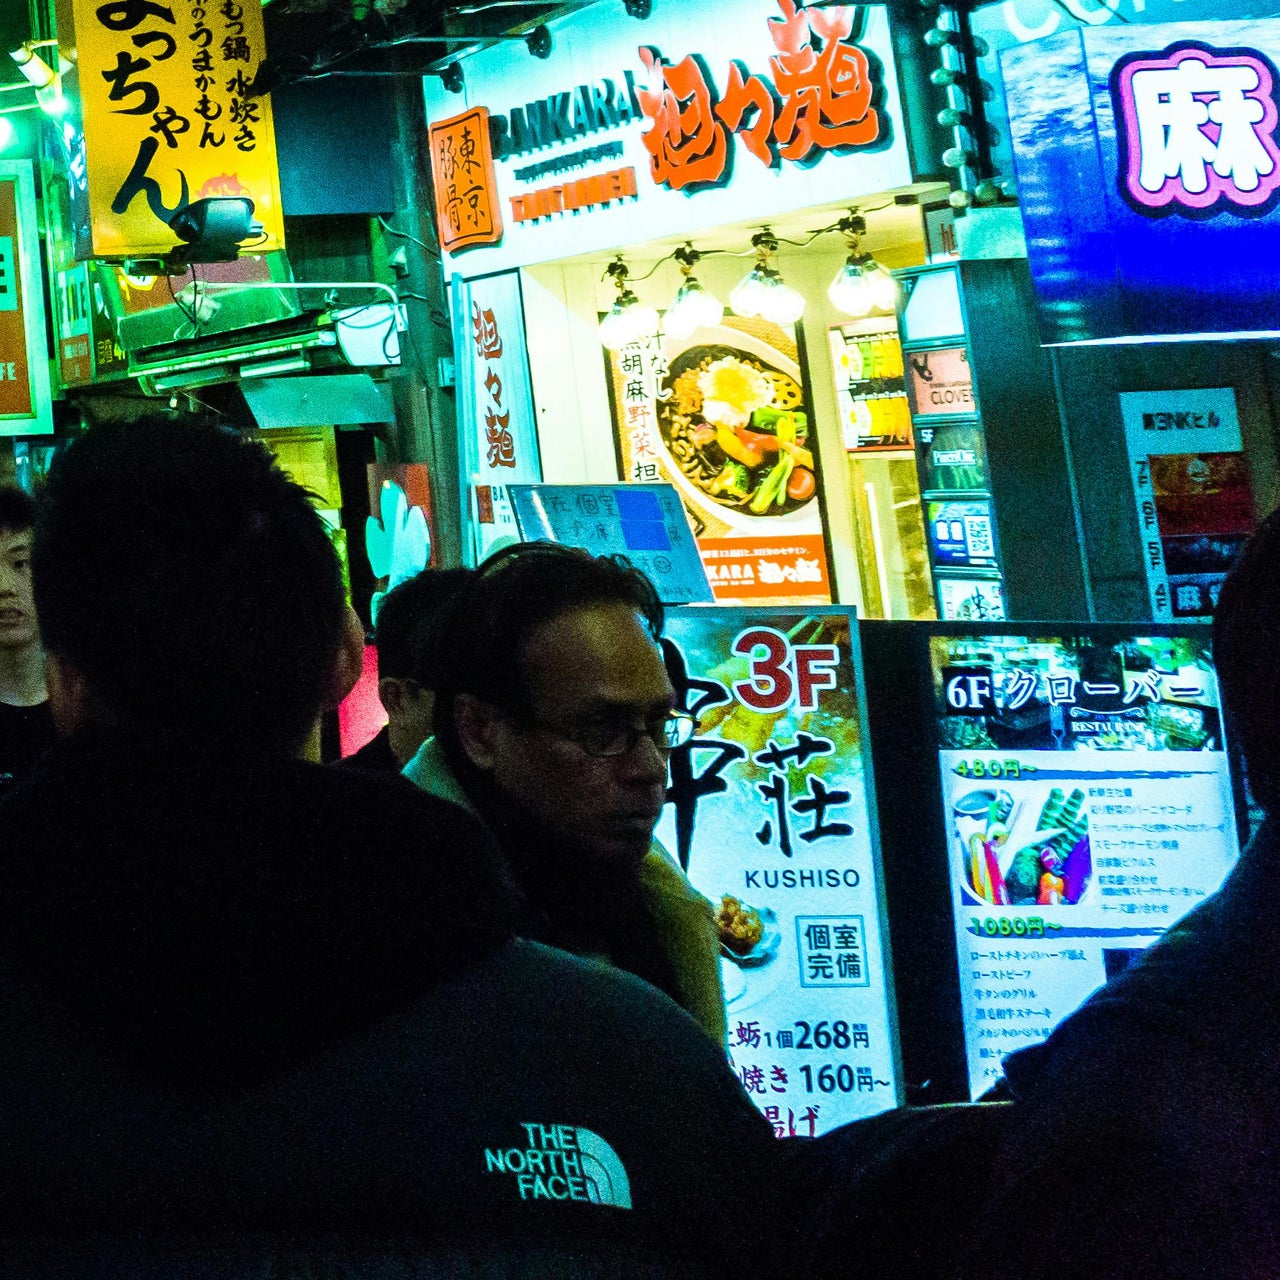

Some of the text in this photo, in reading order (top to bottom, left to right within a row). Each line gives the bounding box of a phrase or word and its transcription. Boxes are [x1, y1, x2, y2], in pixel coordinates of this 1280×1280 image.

[225, 68, 261, 152] 水炊き
[1130, 58, 1274, 194] 麻
[731, 625, 841, 714] 3F
[947, 669, 1206, 711] 6F クローバー
[745, 868, 860, 889] KUSHISO
[805, 924, 860, 951] 個室
[808, 952, 863, 980] 完備
[521, 1122, 576, 1149] THE
[484, 1148, 581, 1176] NORTH
[517, 1174, 589, 1201] FACE
